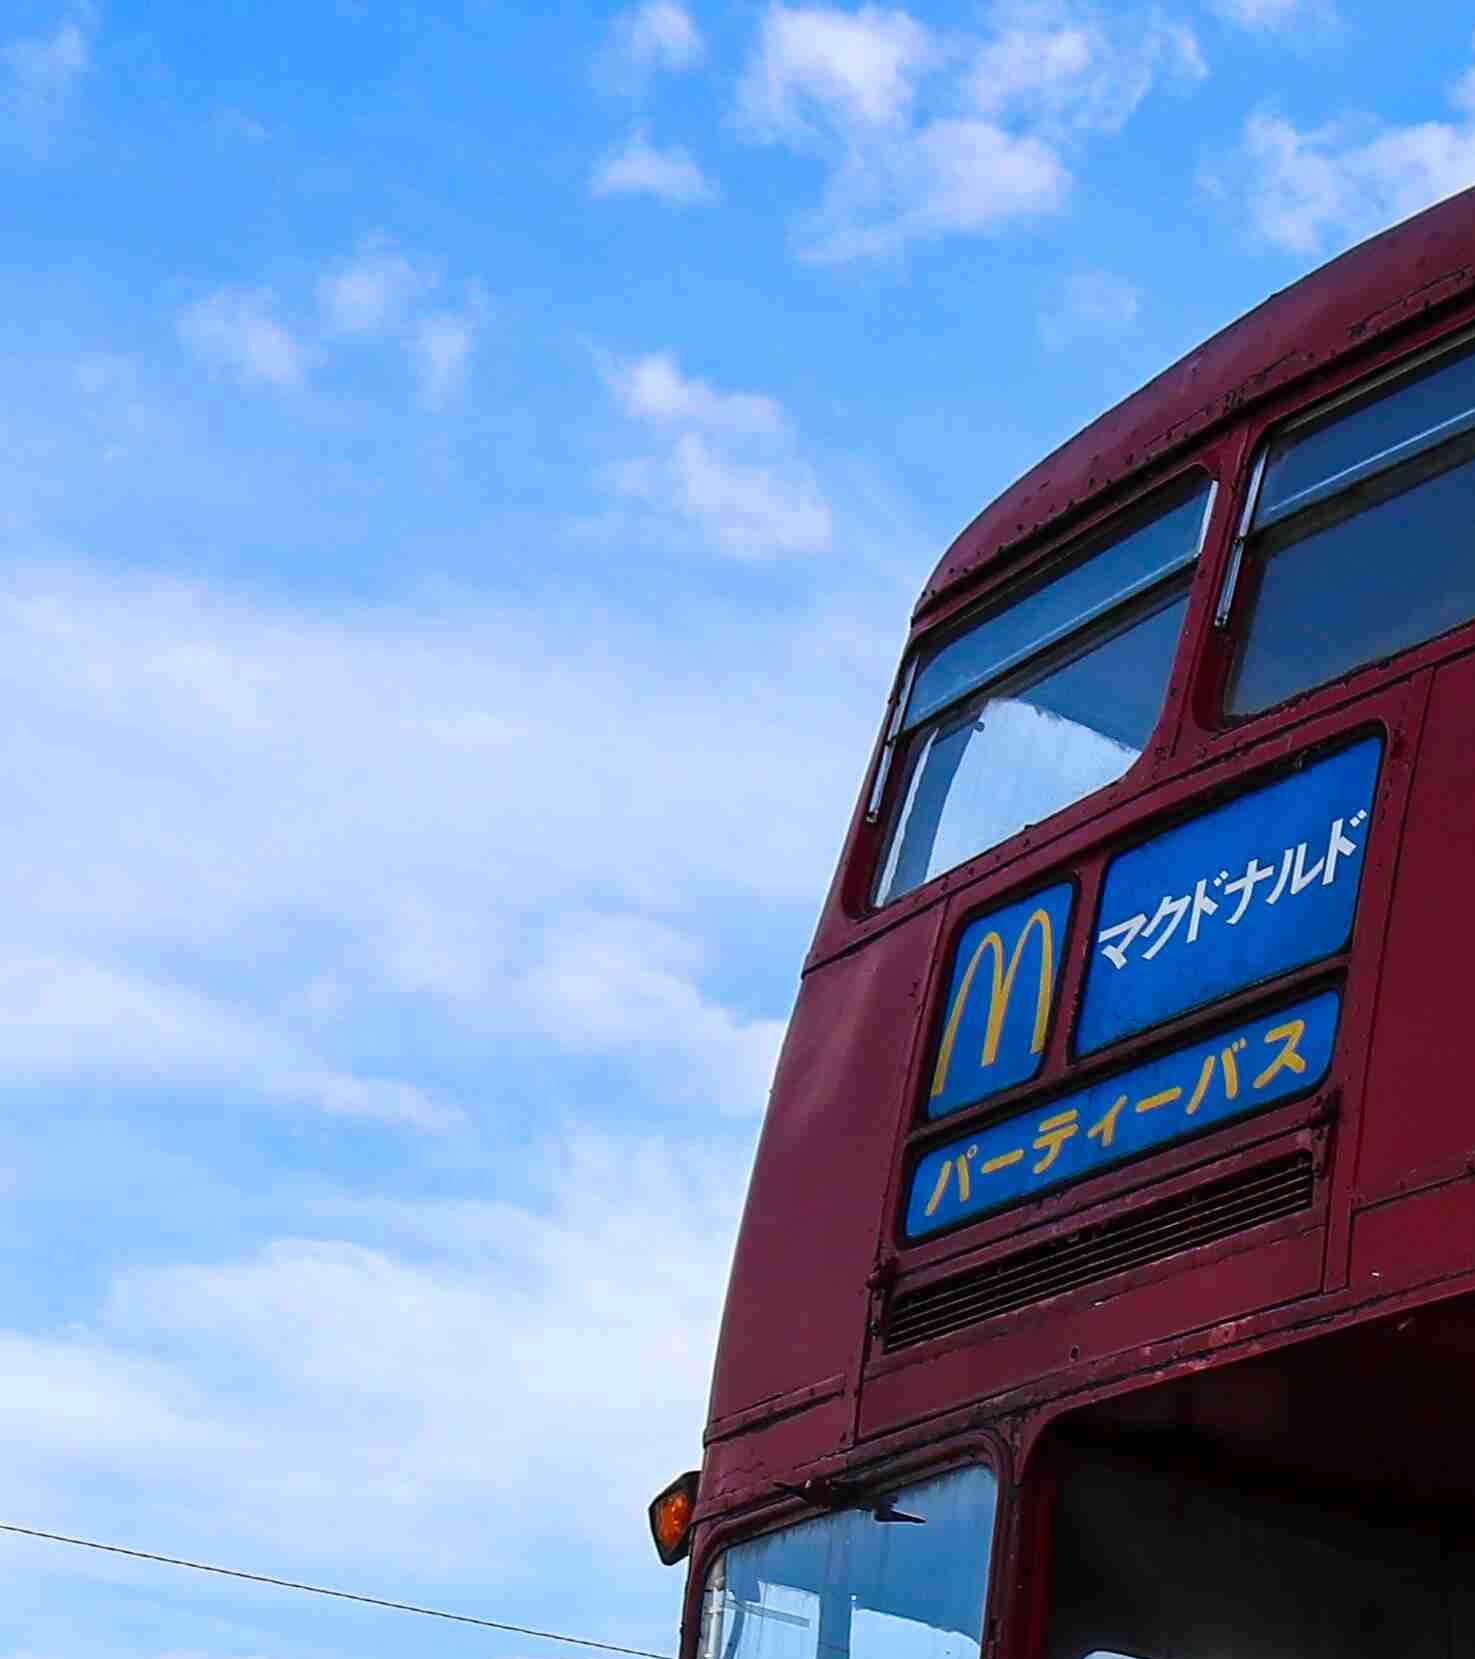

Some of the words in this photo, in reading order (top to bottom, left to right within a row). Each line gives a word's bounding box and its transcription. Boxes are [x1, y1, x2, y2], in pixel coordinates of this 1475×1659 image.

[1098, 809, 1368, 969] マクドナルド
[924, 1018, 1307, 1216] パーティーバス
